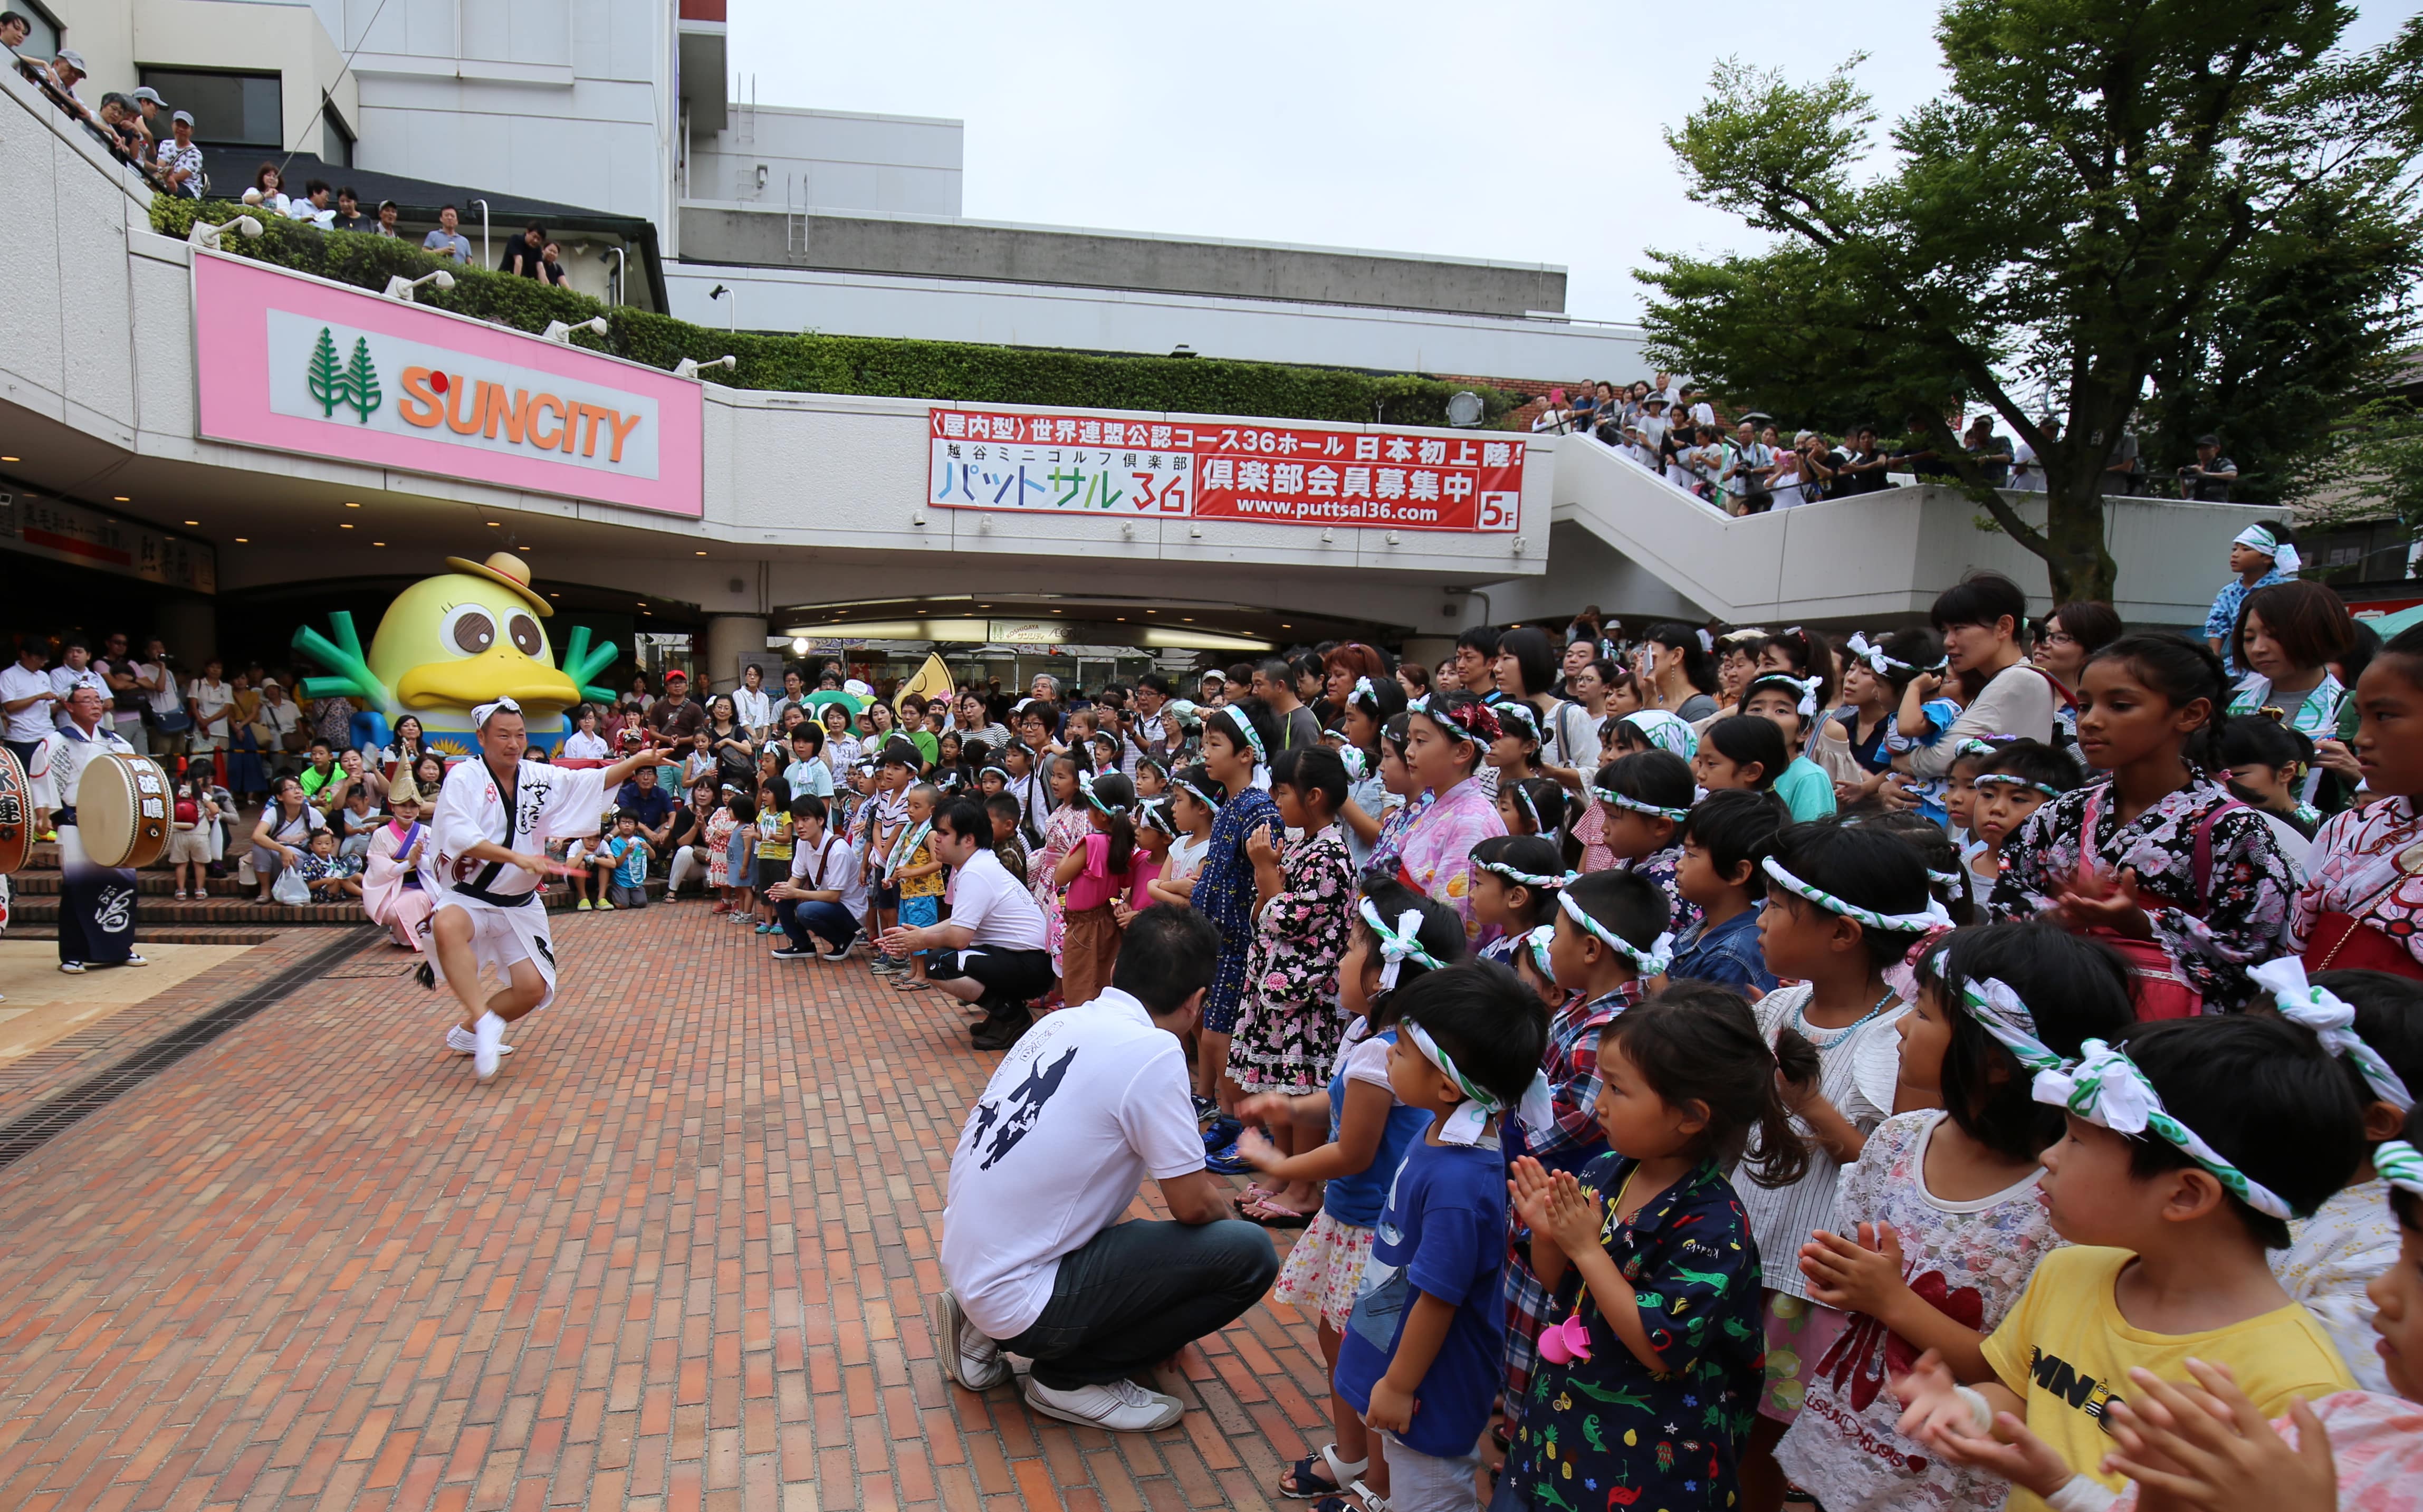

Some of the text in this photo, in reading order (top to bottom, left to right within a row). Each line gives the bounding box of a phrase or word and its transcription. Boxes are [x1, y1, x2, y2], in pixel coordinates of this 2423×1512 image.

[398, 366, 641, 462] SUNCITY
[946, 443, 1187, 471] 越谷ミニゴルフ倶楽部
[1202, 460, 1472, 504] 倶楽部会員募集中
[1237, 498, 1438, 522] www.puttsal36.com
[1006, 624, 1039, 639] KOSHIGAYA
